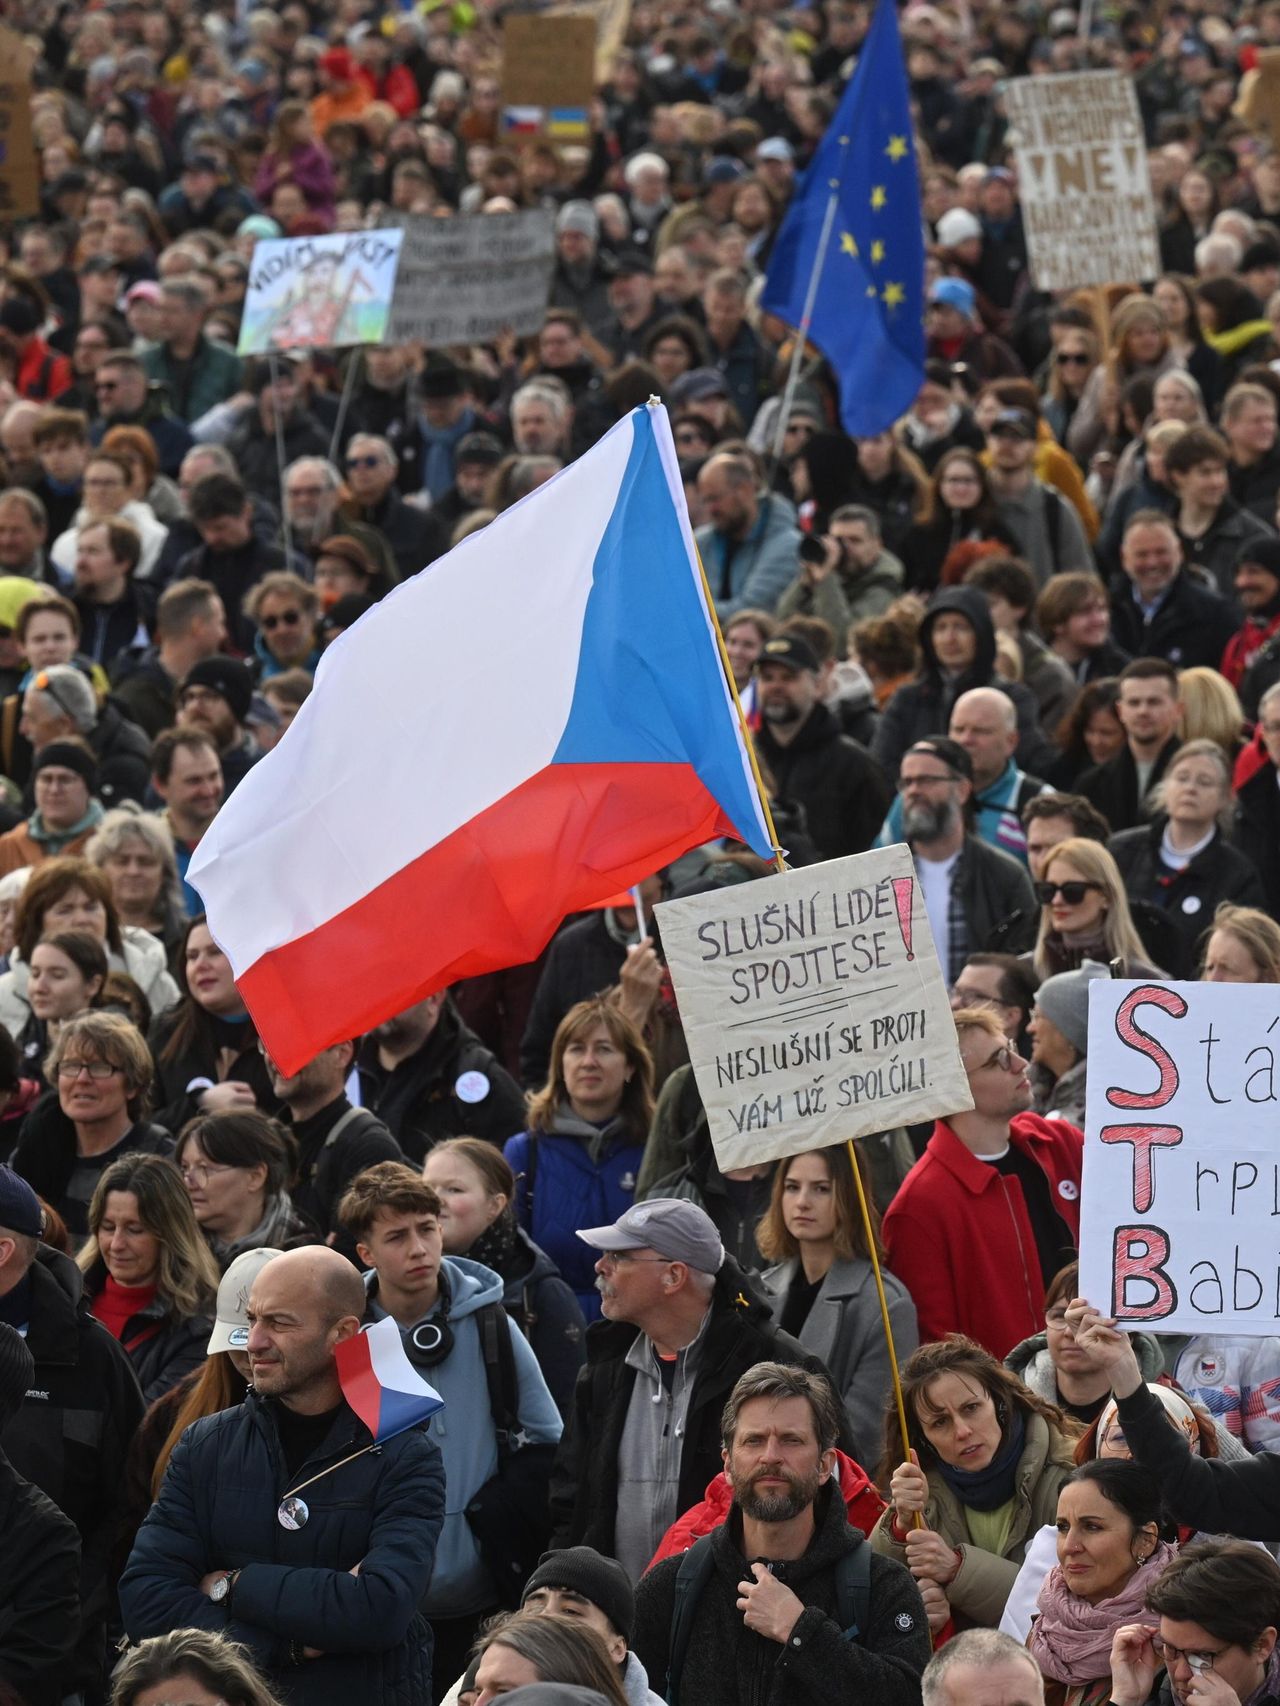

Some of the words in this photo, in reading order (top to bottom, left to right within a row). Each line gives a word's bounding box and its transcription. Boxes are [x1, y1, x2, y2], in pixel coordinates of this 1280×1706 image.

[697, 891, 820, 961] SLUŠNÍ
[715, 1022, 835, 1088] NESLUŠNÍ
[839, 1024, 863, 1054] SE
[870, 1009, 926, 1050] PROTI
[728, 1093, 783, 1134] VÁM
[793, 1074, 827, 1117] UŽ
[837, 1054, 933, 1107] SPOLČILI.
